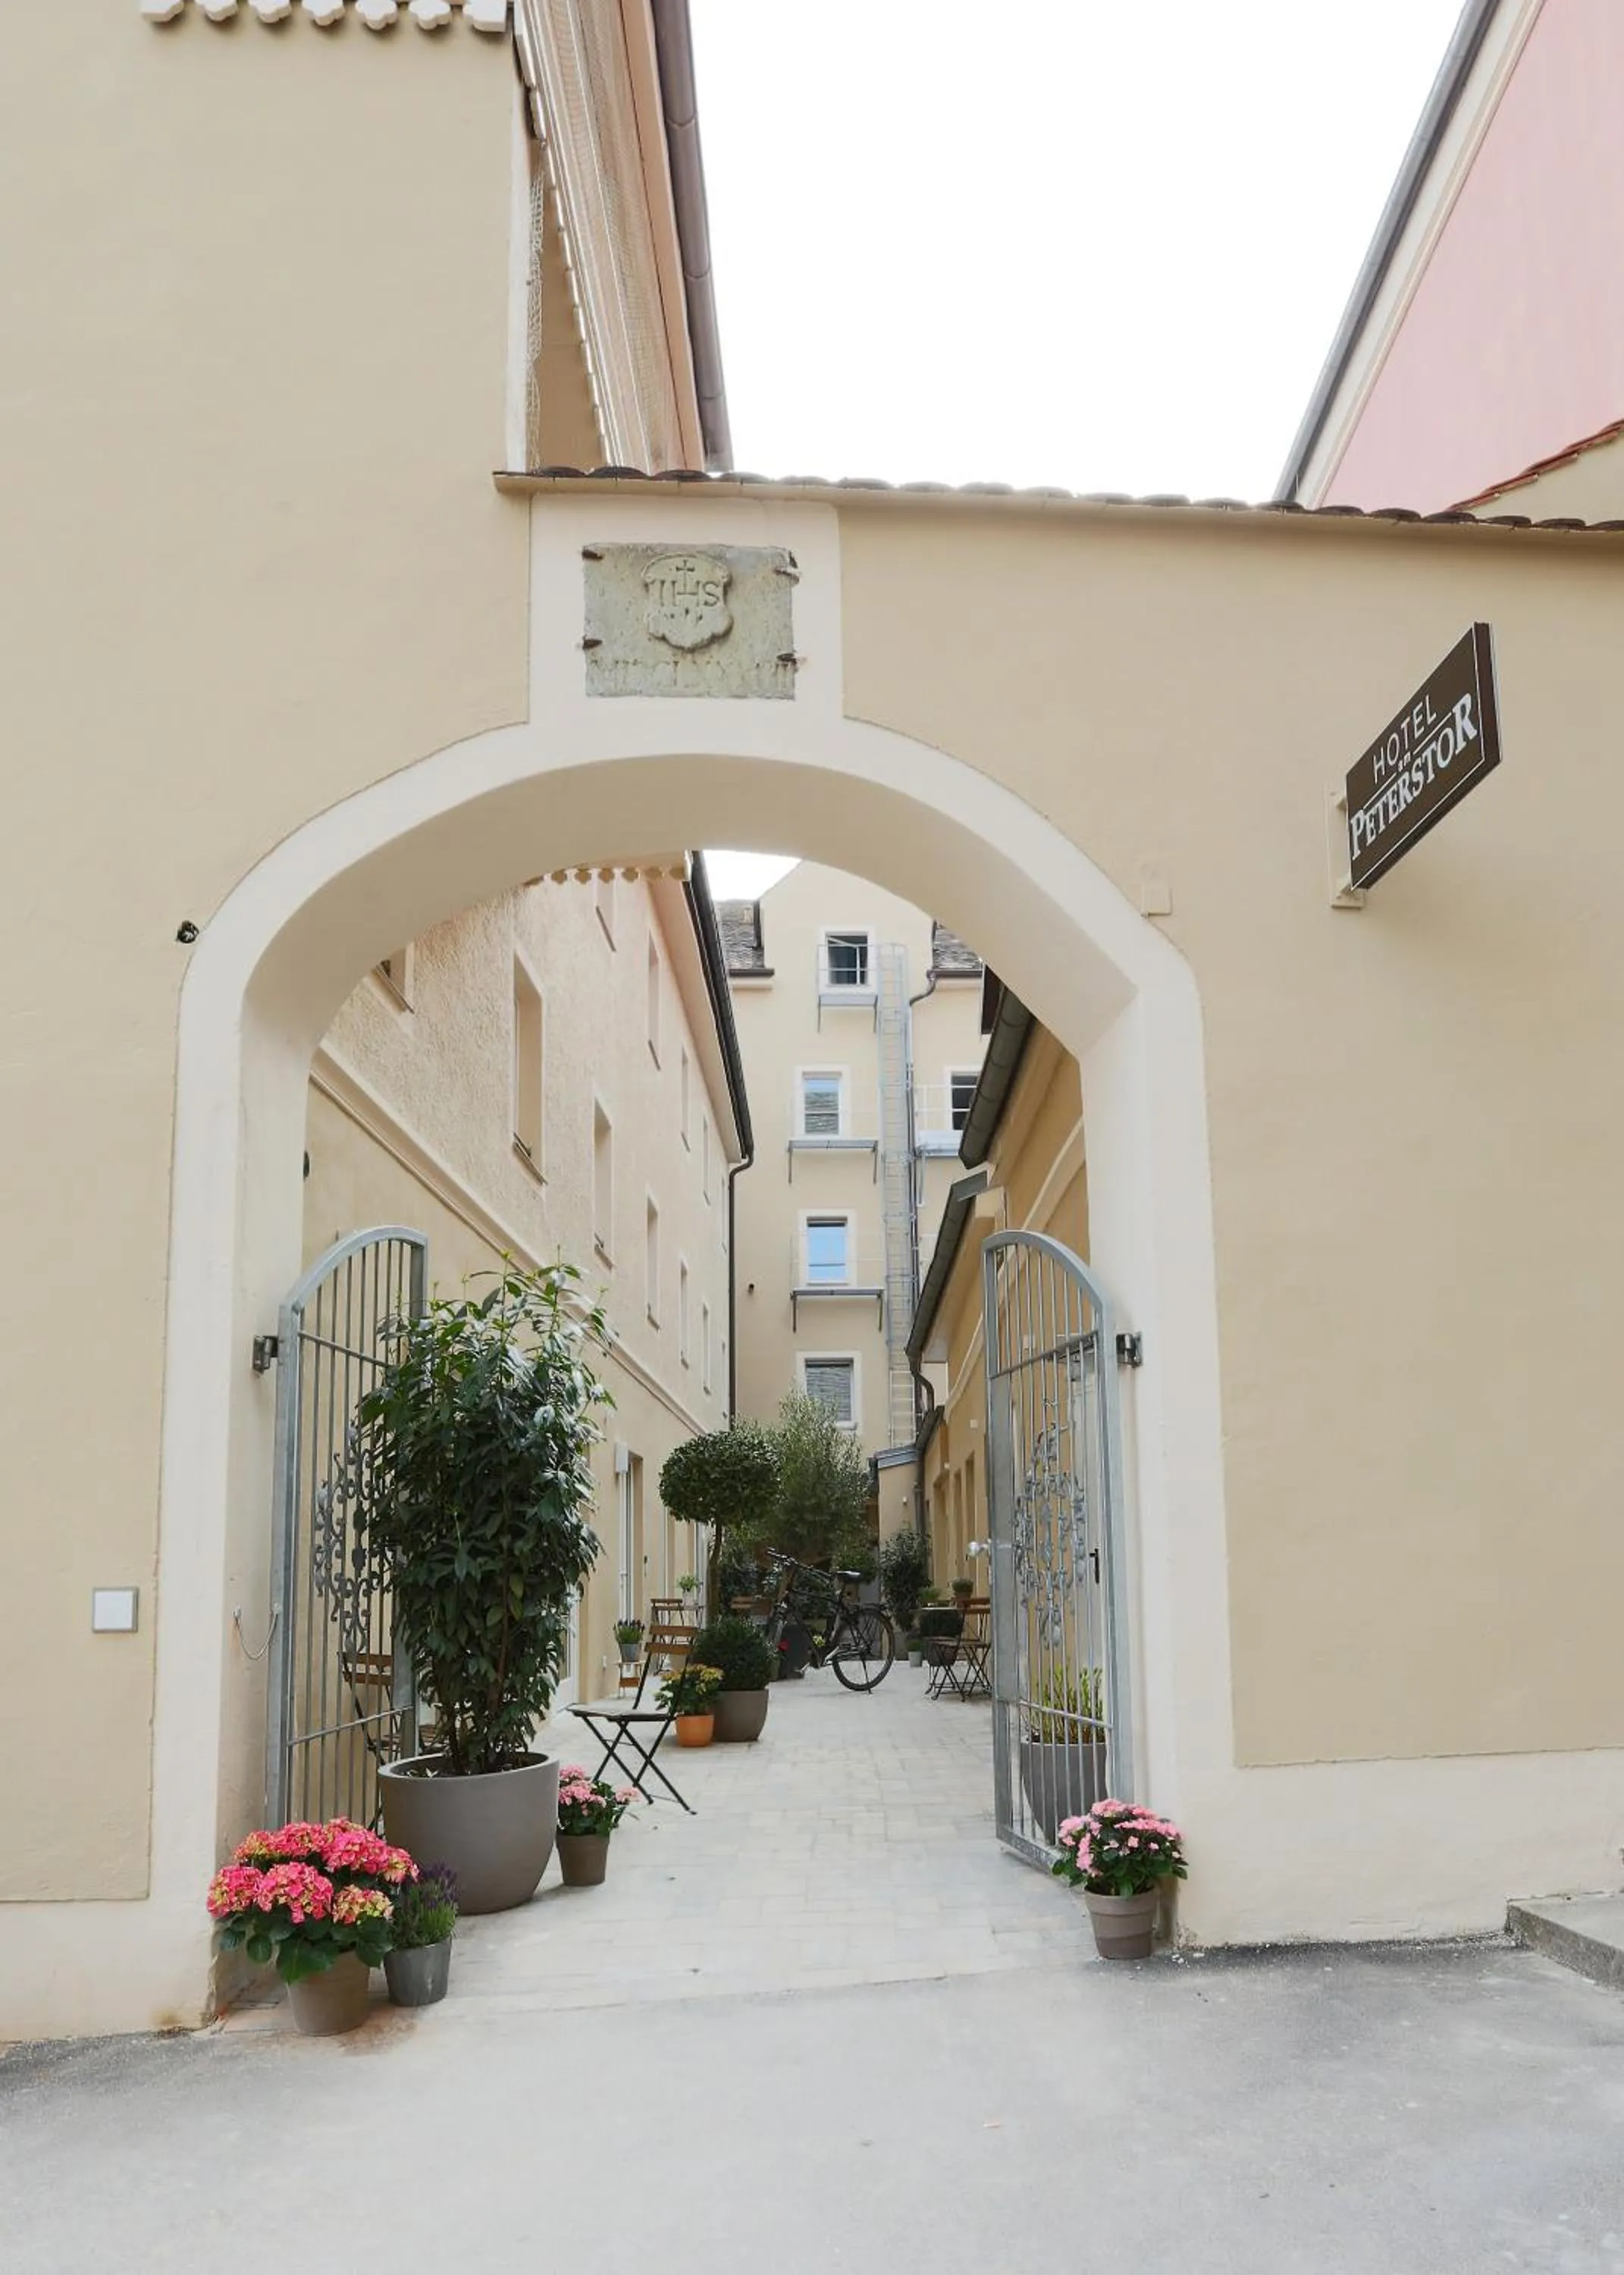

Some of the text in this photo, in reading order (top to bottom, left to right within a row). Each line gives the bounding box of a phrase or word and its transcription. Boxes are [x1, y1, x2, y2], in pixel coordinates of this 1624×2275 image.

[659, 580, 720, 607] IHS
[1350, 692, 1478, 861] PETERSTOR
[1373, 694, 1437, 783] HOTEL
